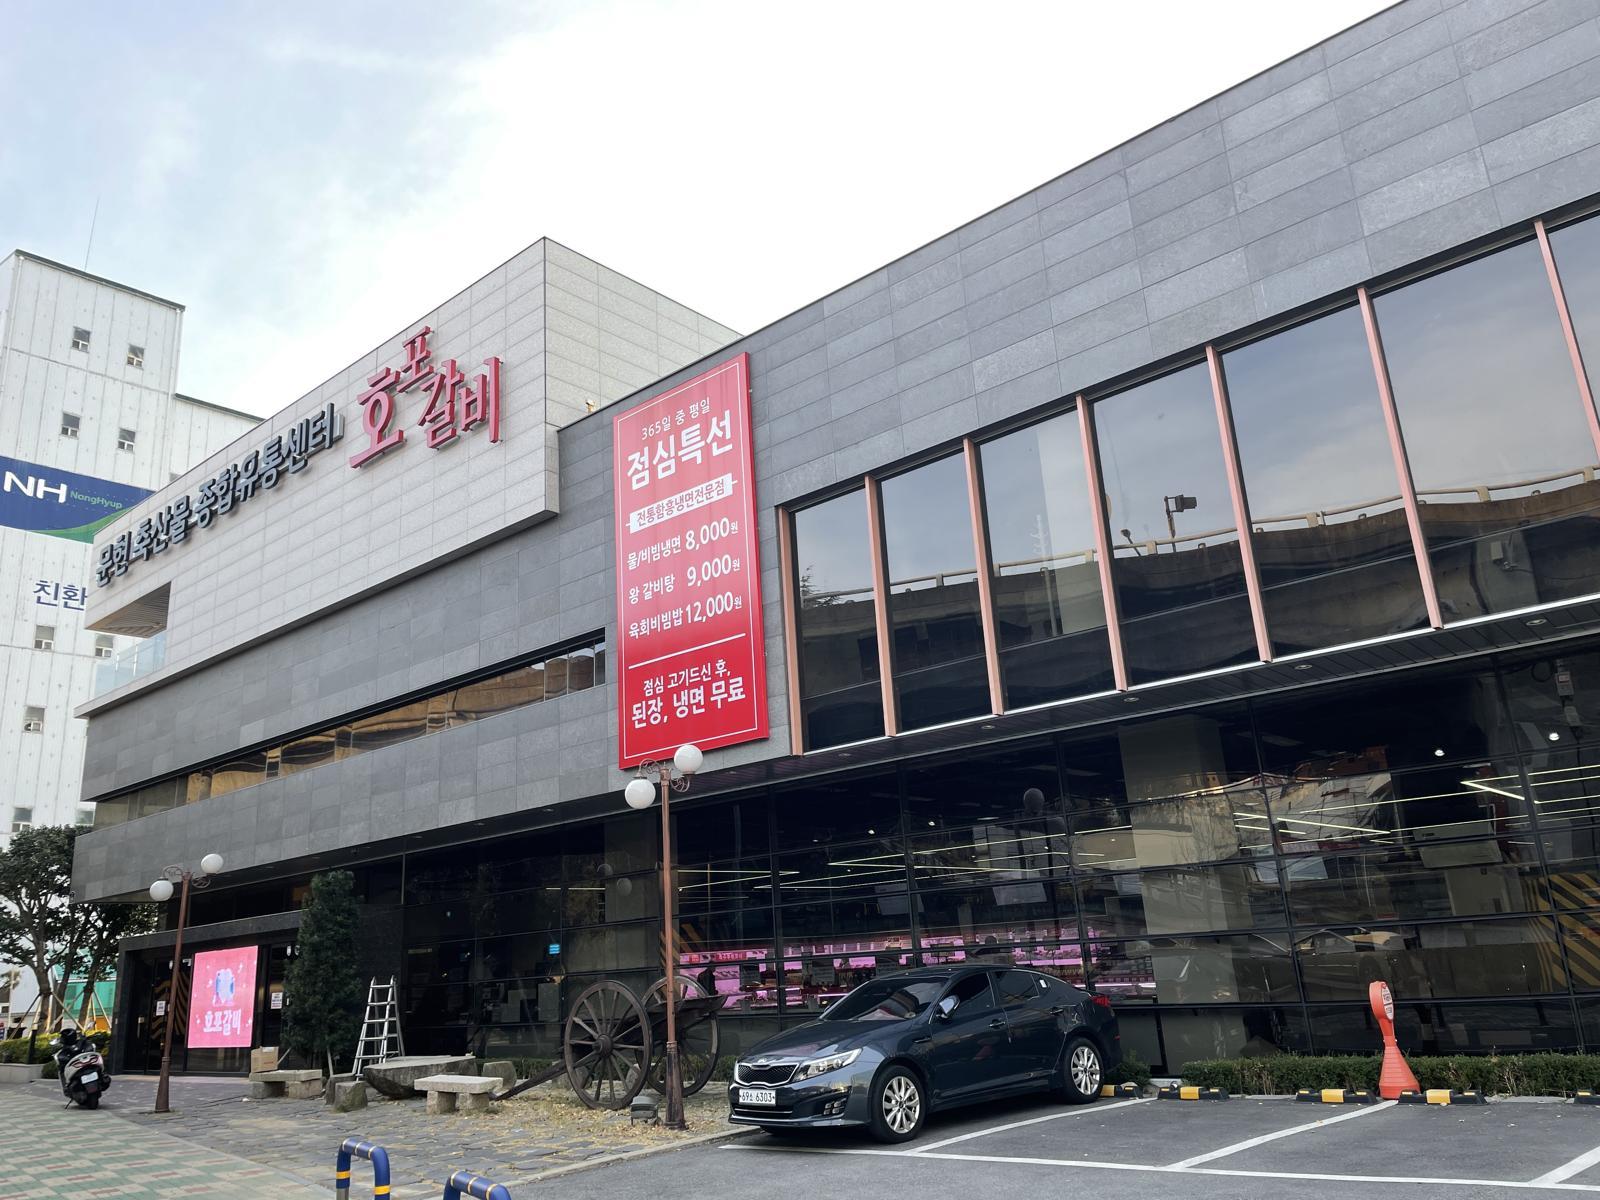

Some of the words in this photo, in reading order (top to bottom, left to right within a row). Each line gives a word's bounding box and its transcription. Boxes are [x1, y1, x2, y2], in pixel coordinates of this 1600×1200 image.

[641, 415, 671, 441] 365일
[675, 409, 686, 426] 중
[689, 397, 710, 419] 평일
[627, 409, 733, 491] 점심특선
[4, 471, 67, 504] NH
[70, 490, 123, 510] NongHyup
[96, 531, 132, 588] 문현
[131, 495, 192, 562] 축산물
[194, 402, 335, 529] 종합유통센터
[636, 479, 725, 527] 전통함흥냉면전문점
[627, 535, 681, 571] 물/비빔냉면
[685, 517, 739, 551] 8,000원
[33, 580, 88, 611] 친환
[629, 586, 640, 605] 왕
[642, 573, 675, 601] 갈비탕
[687, 554, 740, 587] 9,000원
[629, 607, 683, 639] 육회비빔밥
[685, 591, 742, 623] 12,000원
[643, 675, 664, 697] 점심
[667, 664, 712, 690] 고기드신
[715, 658, 731, 676] 후,
[631, 696, 668, 729] 된장,
[673, 685, 705, 719] 냉면
[710, 676, 746, 710] 무료
[755, 1092, 772, 1102] 6303
